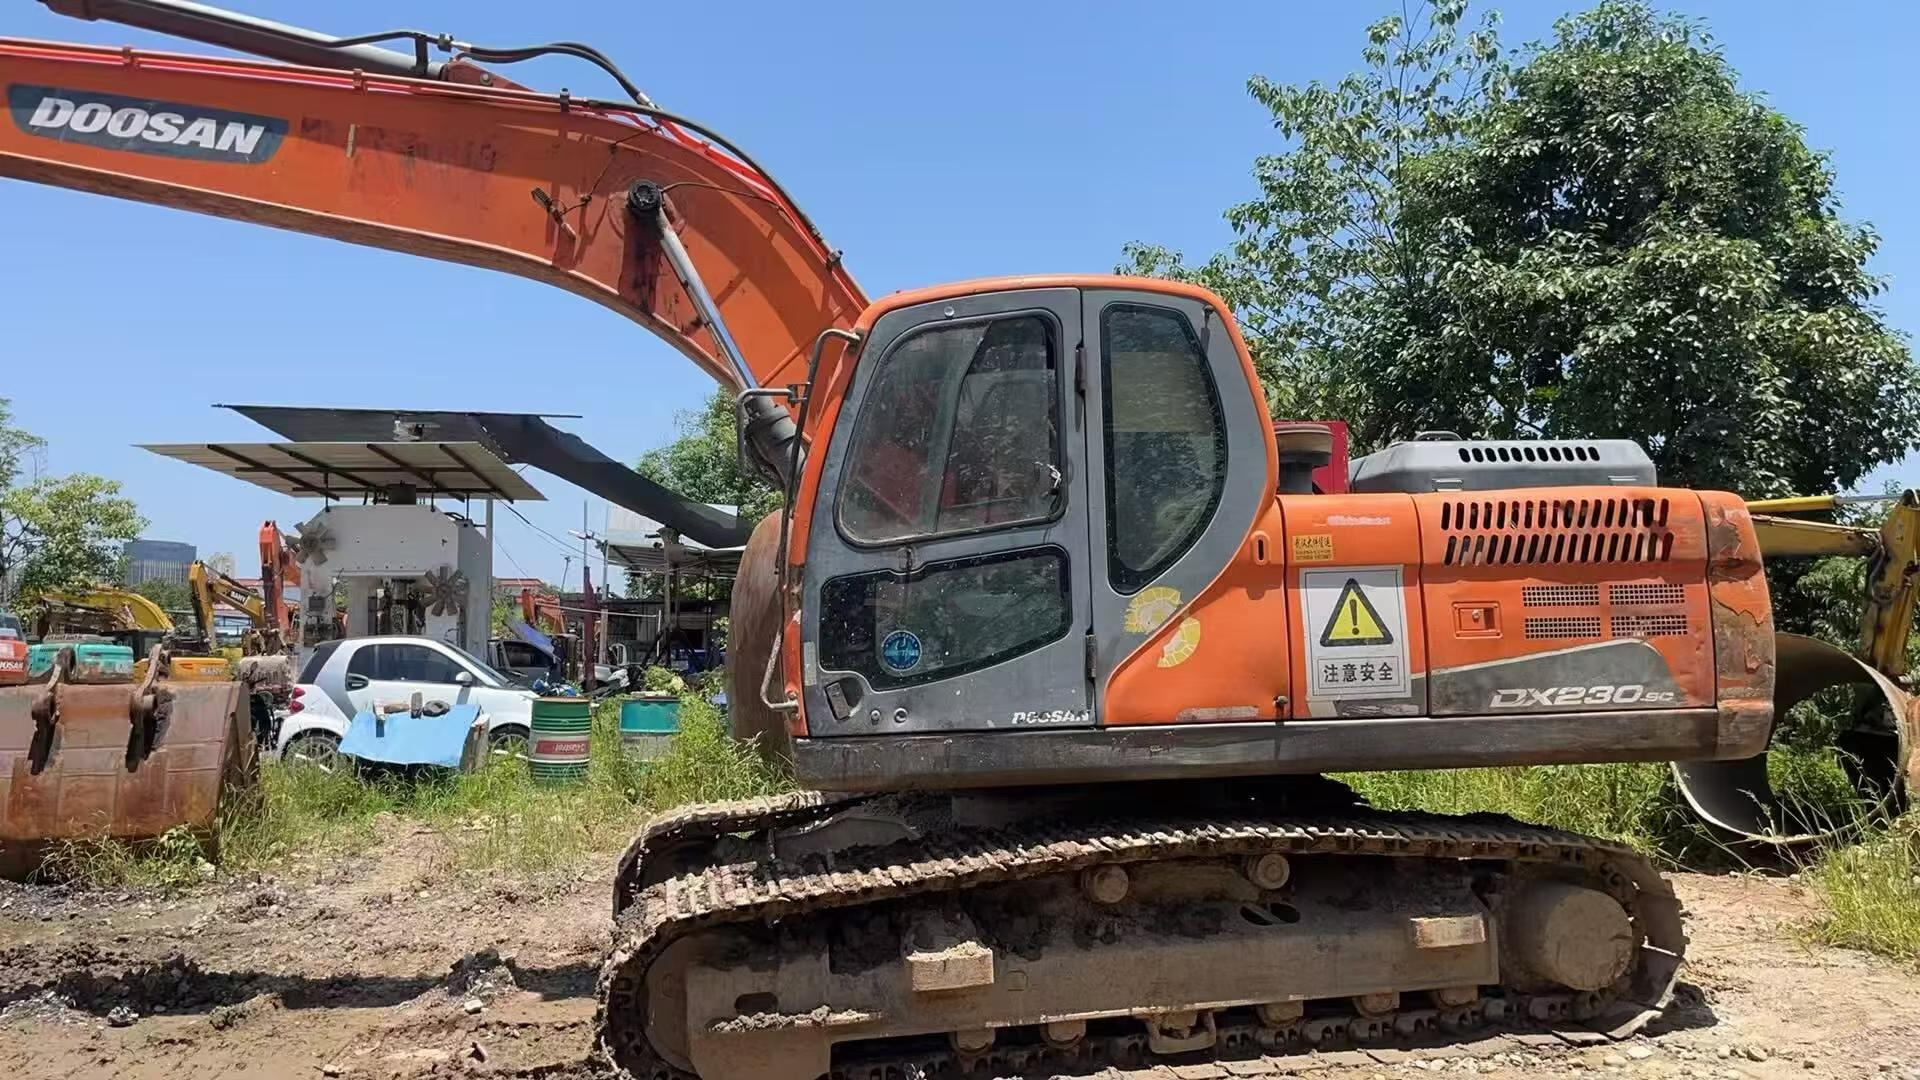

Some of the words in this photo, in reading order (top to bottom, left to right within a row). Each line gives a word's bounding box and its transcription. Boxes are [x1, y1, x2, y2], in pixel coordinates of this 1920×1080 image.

[28, 96, 265, 154] DOOSAN
[1323, 662, 1393, 683] 注意安全
